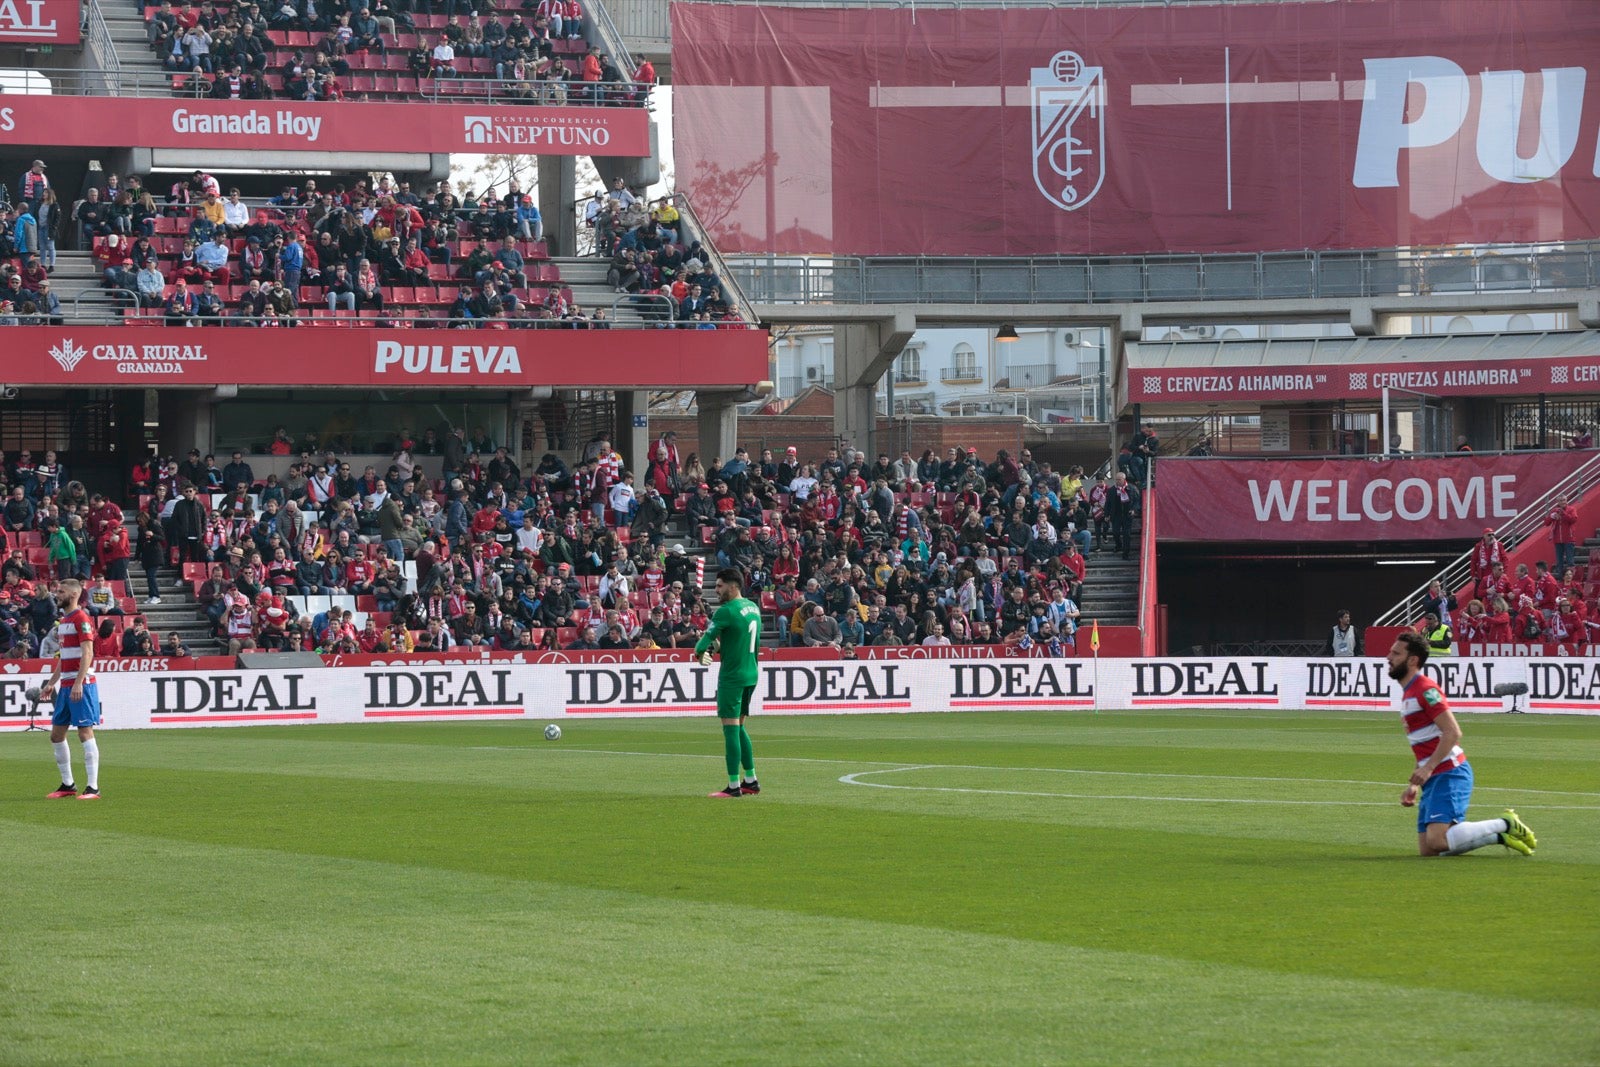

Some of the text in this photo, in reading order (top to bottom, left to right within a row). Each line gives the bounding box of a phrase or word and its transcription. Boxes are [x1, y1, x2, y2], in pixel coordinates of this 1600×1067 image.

[172, 109, 321, 142] Granada Hoy
[495, 125, 610, 146] NEPTUNO
[543, 117, 608, 125] COMERCIAL
[1353, 56, 1600, 189] PU
[92, 345, 208, 361] CAJA RURAL
[116, 362, 184, 374] GRANADA
[374, 340, 522, 374] PULEVA
[1167, 374, 1327, 392] CERVEZAS ALHAMBRA SIN
[1372, 368, 1532, 388] CERVEZAS ALHAMBRA SIN
[1573, 365, 1600, 382] CER
[1247, 475, 1519, 522] WELCOME
[748, 620, 757, 653] 1
[150, 674, 317, 714] IDEAL
[364, 670, 523, 708] IDEAL
[565, 668, 718, 705] IDEAL
[763, 665, 910, 701] IDEAL
[950, 663, 1094, 698] IDEAL
[1131, 662, 1278, 696] IDEAL
[1306, 662, 1391, 698] IDEAL
